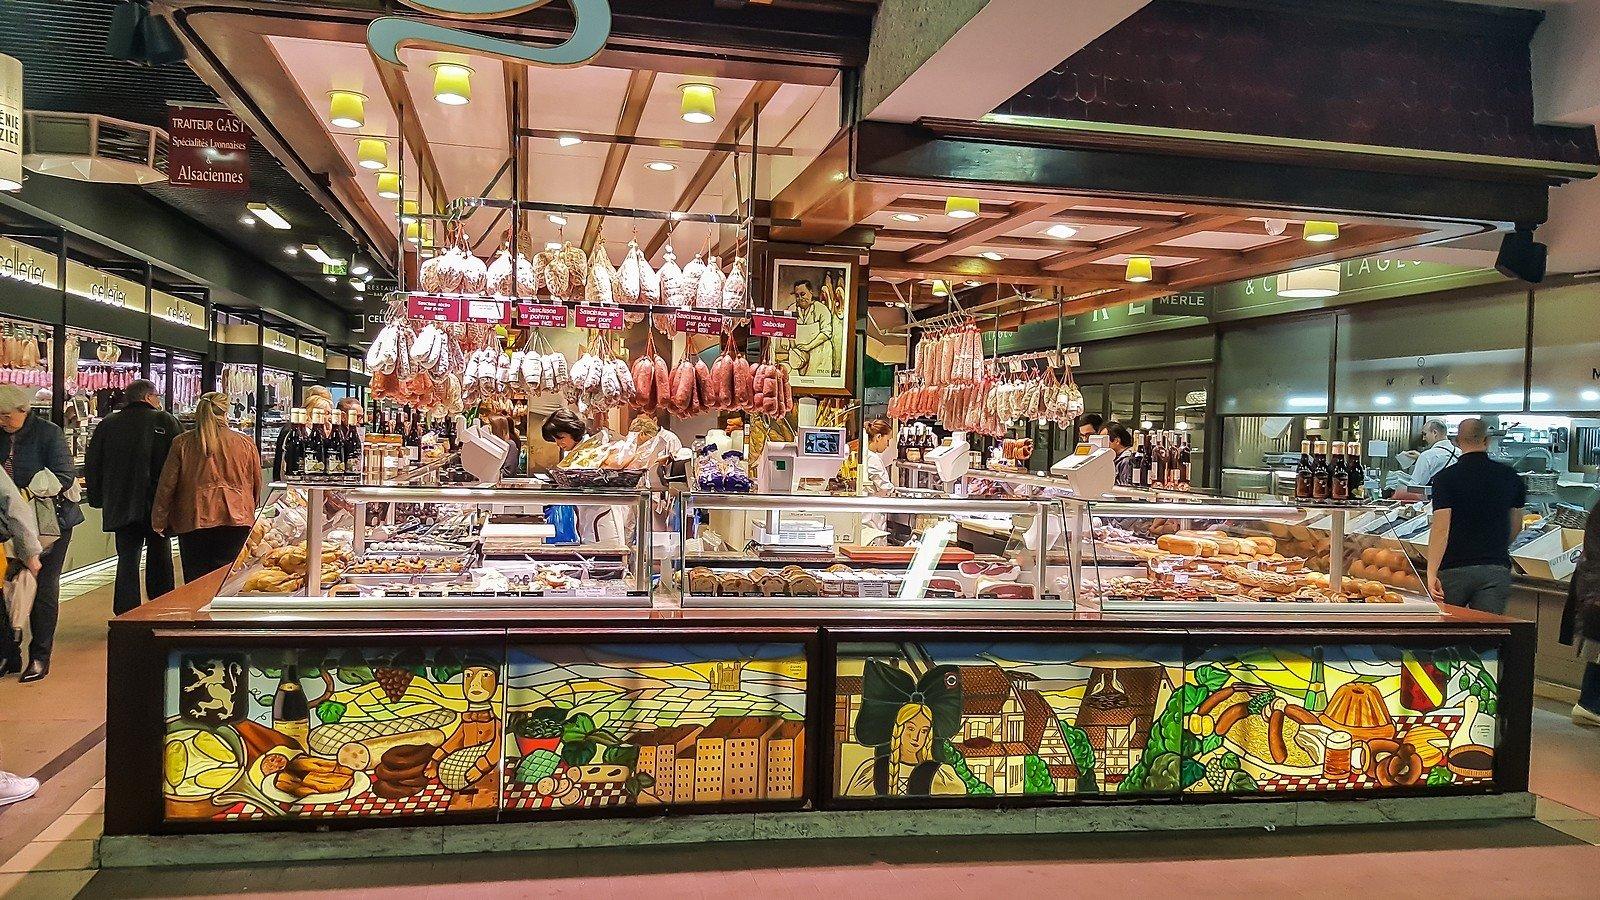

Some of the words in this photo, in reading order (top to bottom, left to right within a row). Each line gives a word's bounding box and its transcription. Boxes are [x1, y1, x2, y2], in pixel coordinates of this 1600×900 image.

[172, 117, 214, 131] TRAITEUR
[172, 136, 209, 148] Spécialités
[210, 138, 247, 150] Lyonnaises
[178, 165, 244, 184] Alsaciennes
[1245, 280, 1255, 295] &
[1159, 295, 1205, 306] MERLE
